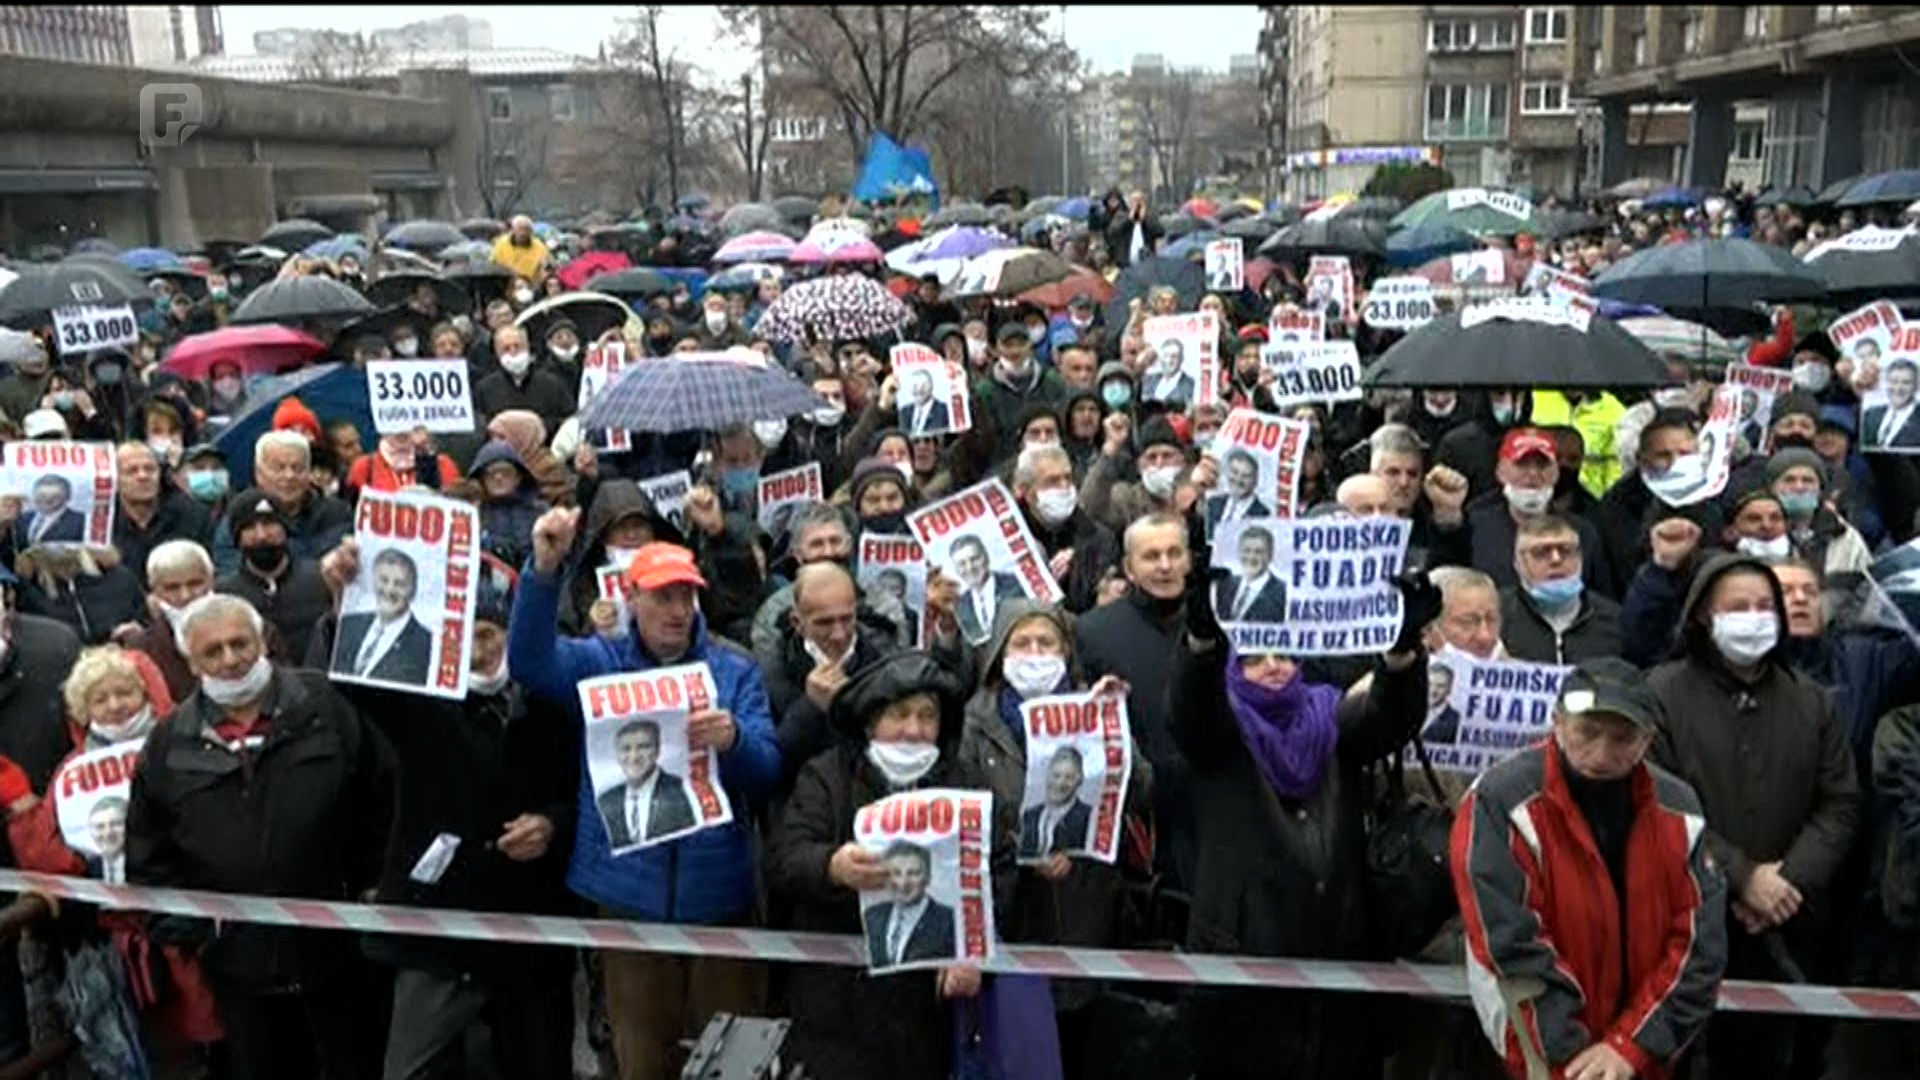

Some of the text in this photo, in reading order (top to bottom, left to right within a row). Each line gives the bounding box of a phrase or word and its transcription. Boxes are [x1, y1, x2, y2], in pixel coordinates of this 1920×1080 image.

[1369, 300, 1431, 320] 33.000
[63, 316, 133, 346] 33.000
[374, 371, 463, 400] 33.000
[16, 445, 87, 468] FUDO
[763, 472, 807, 503] FUDO
[358, 498, 445, 543] FUDO
[914, 492, 987, 545] FUDO
[863, 540, 922, 565] FUDO
[1293, 523, 1400, 552] PODRŠKA
[1292, 554, 1398, 588] FUADU
[1322, 630, 1349, 649] UZ
[588, 675, 682, 719] FUDO
[1029, 701, 1099, 738] FUDO
[861, 796, 954, 836] FUDO
